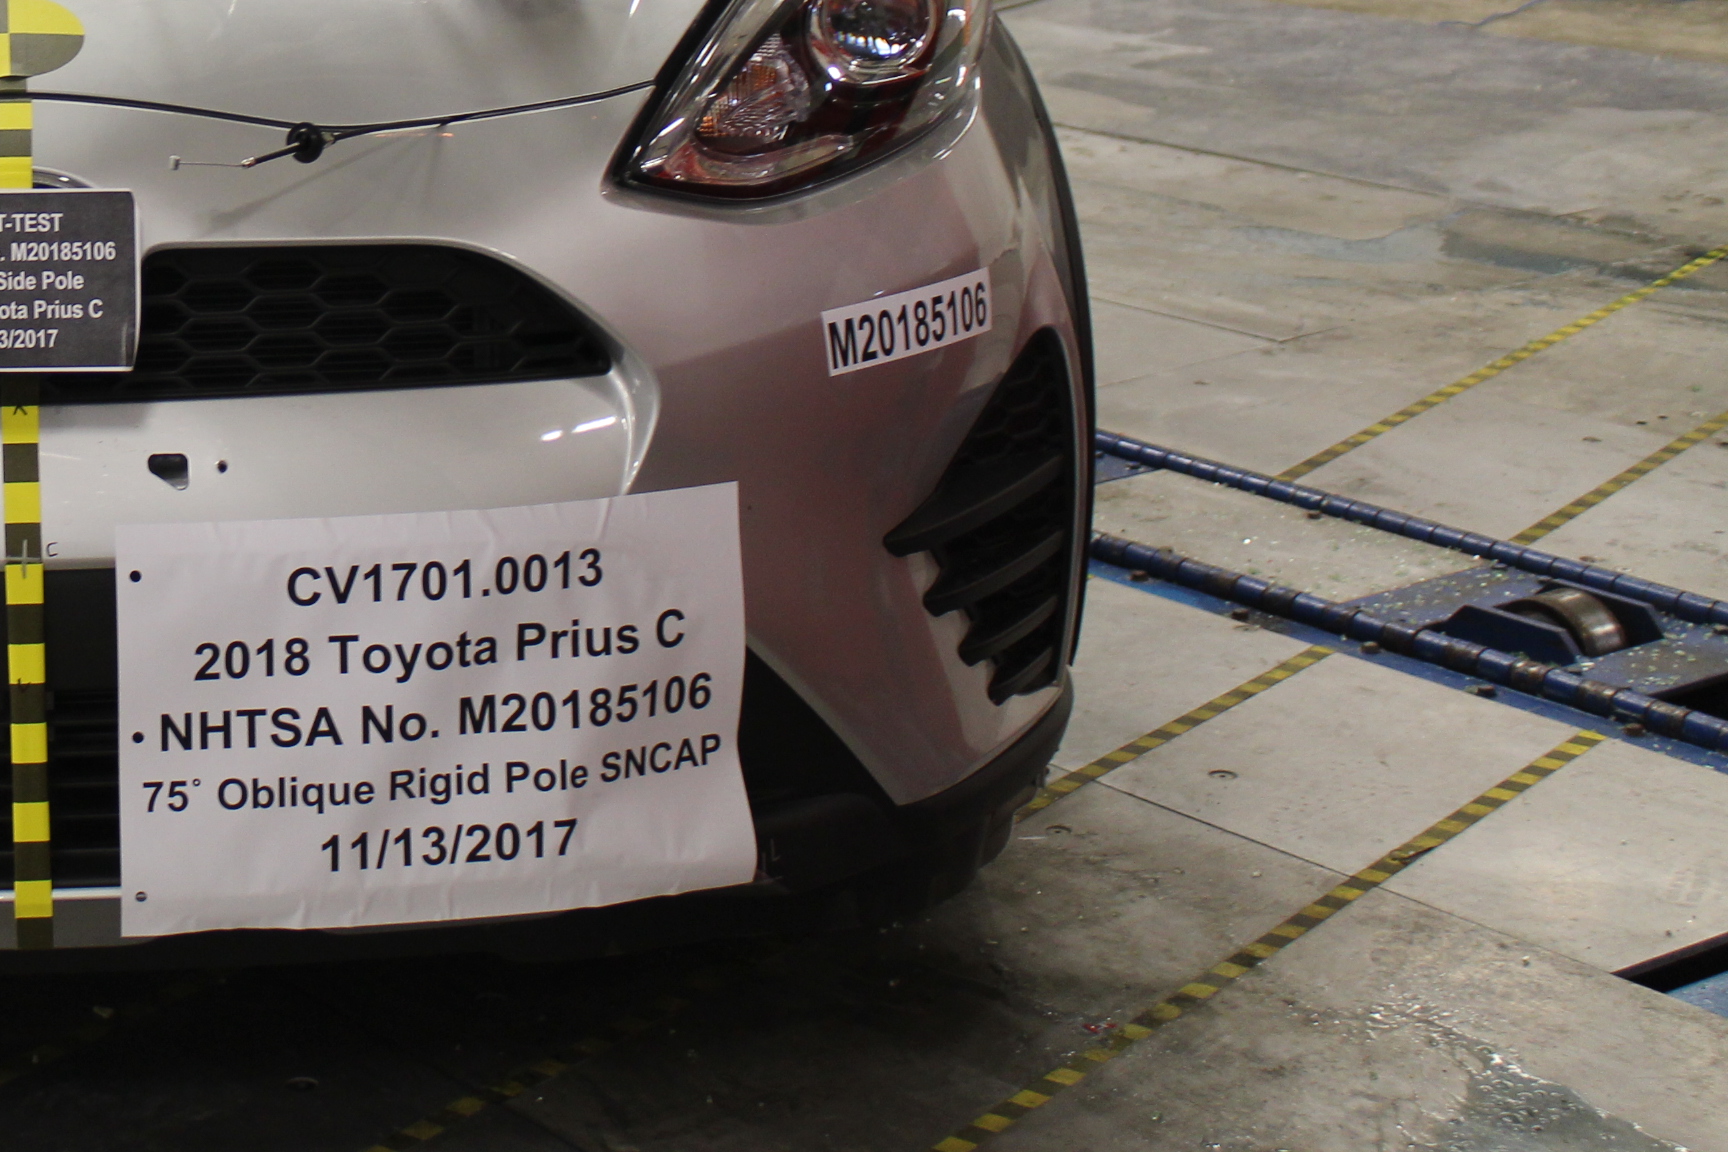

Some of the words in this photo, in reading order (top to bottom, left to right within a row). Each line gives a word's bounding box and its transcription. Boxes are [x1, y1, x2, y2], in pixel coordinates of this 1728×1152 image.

[10, 241, 117, 262] M20185106
[41, 271, 84, 290] Pole
[33, 300, 83, 320] Prius
[88, 299, 103, 319] C
[828, 281, 987, 370] M20185106
[286, 548, 604, 607] CV1701.0013
[193, 637, 311, 681] 2018
[328, 628, 498, 683] Toyota
[515, 617, 639, 662] Prius
[655, 608, 686, 649] C
[159, 706, 343, 751] NHTSA
[360, 703, 440, 746] No.
[458, 671, 712, 736] M20185106
[143, 777, 202, 813] 75°
[217, 774, 375, 815] Oblique
[389, 762, 490, 806] Rigid
[505, 759, 588, 794] Pole
[599, 732, 722, 784] SNCAP
[320, 818, 578, 872] 11/13/2017
